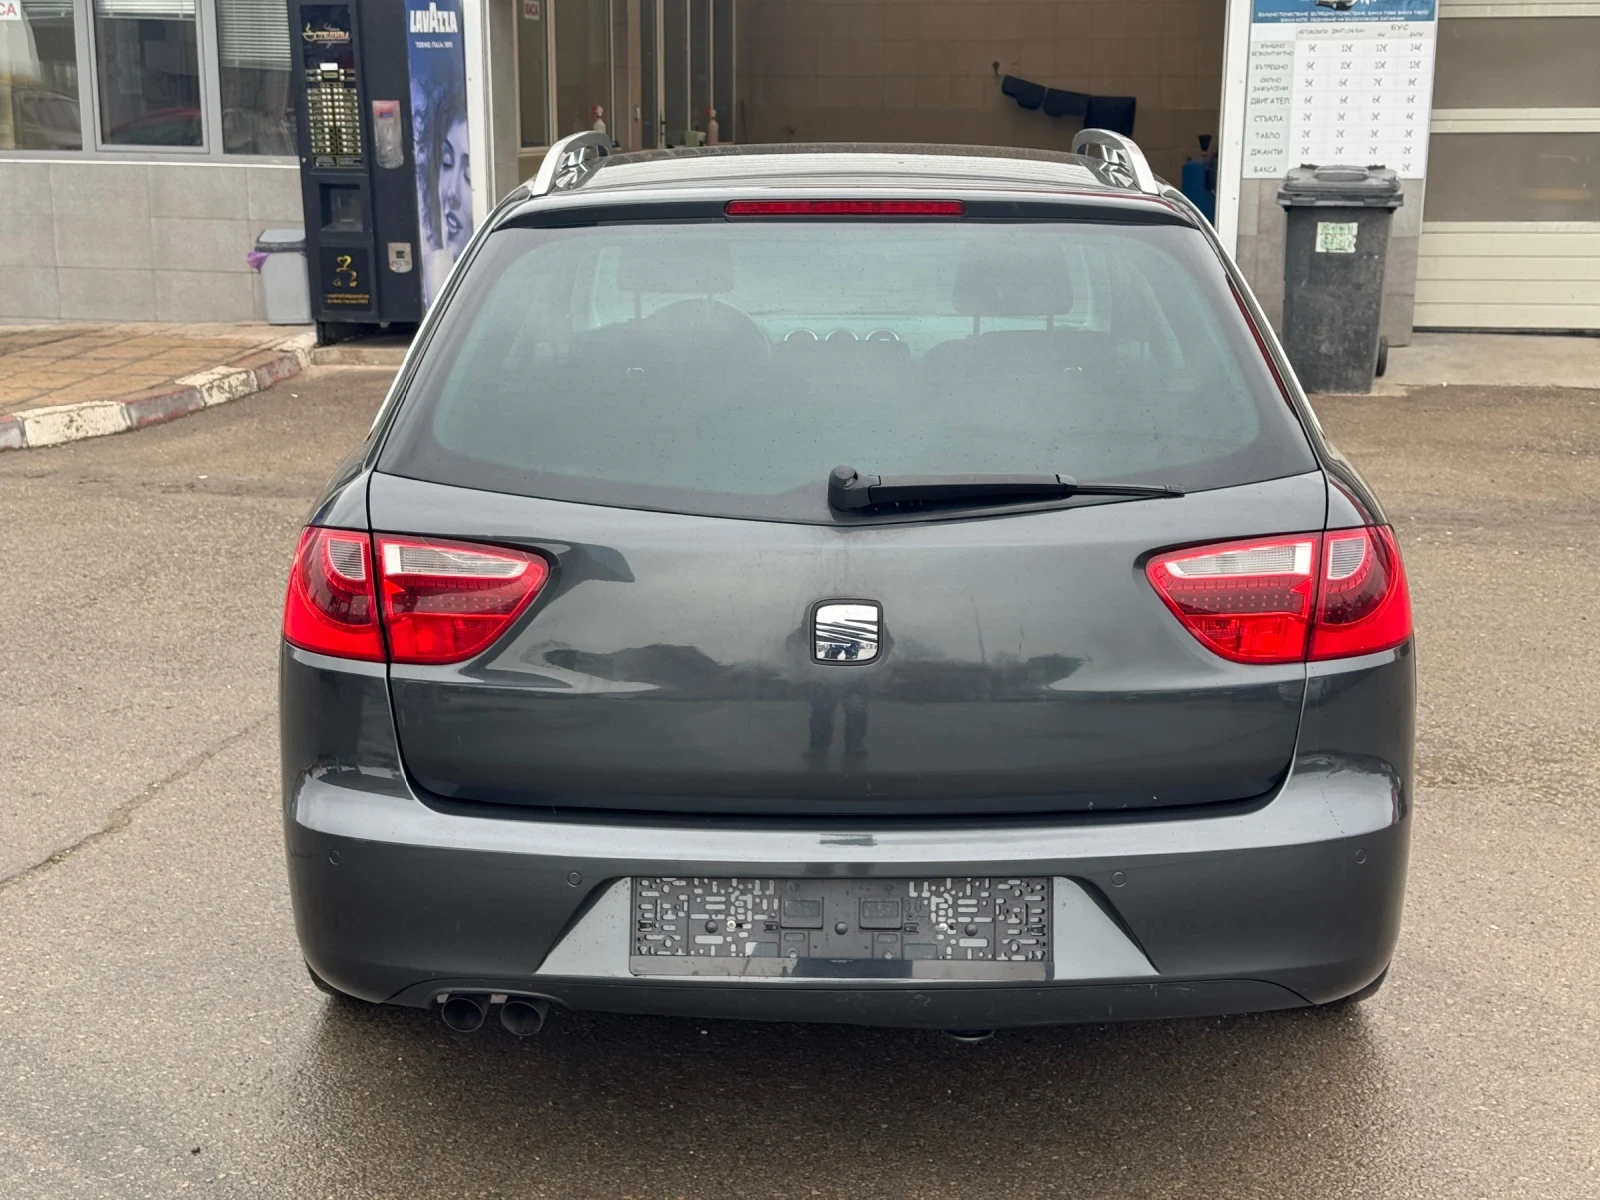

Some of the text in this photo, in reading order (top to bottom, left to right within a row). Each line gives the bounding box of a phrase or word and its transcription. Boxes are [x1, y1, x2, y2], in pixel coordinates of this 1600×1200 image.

[410, 2, 458, 33] LAVAZZA
[1340, 43, 1354, 53] 12€
[1375, 43, 1389, 53] 12€
[1409, 59, 1422, 70] 12€
[1373, 77, 1383, 87] 7€
[1250, 96, 1290, 105] ДВИГАТЕЛ
[1253, 114, 1284, 123] СТЪКЛА
[1302, 112, 1313, 122] 2€
[1405, 111, 1415, 121] 4€
[1255, 131, 1281, 140] ТАБЛО
[1301, 129, 1312, 139] 2€
[1335, 129, 1346, 139] 2€
[1250, 148, 1284, 157] ДЖАНТИ
[1300, 146, 1311, 156] 2€
[1334, 146, 1345, 156] 2€
[1368, 145, 1379, 156] 2€
[1402, 145, 1413, 155] 2€
[1253, 165, 1278, 174] ВАКСА
[1401, 162, 1412, 172] 2€
